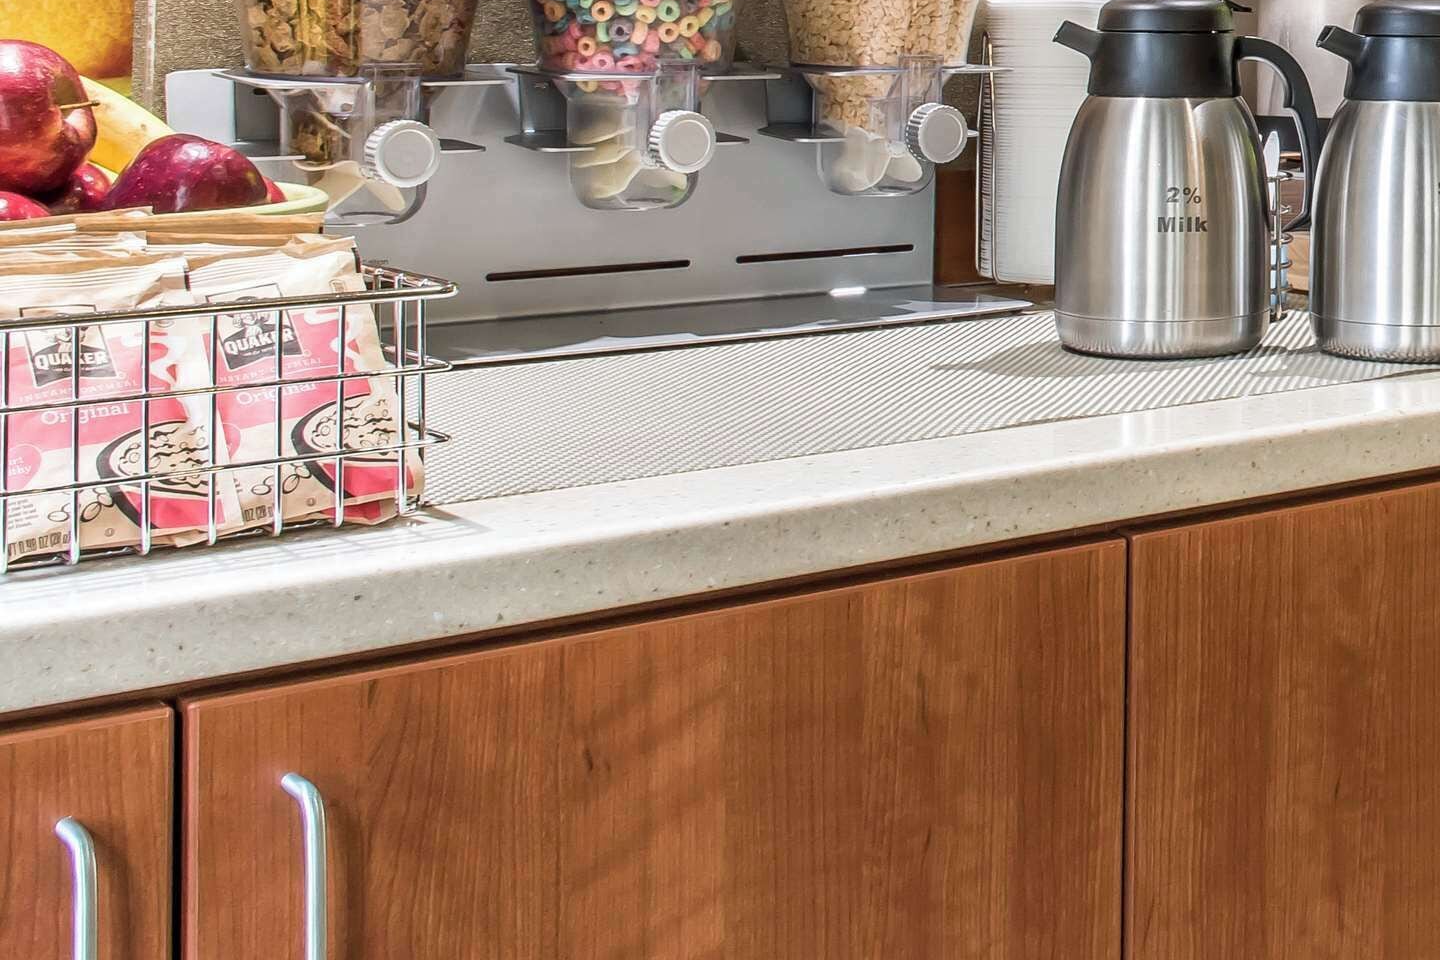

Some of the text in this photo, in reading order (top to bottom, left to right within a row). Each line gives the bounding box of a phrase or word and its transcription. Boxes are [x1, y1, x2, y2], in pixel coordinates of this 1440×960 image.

[1166, 186, 1202, 204] 2%
[1157, 216, 1209, 233] Milk
[40, 401, 130, 426] Orginal
